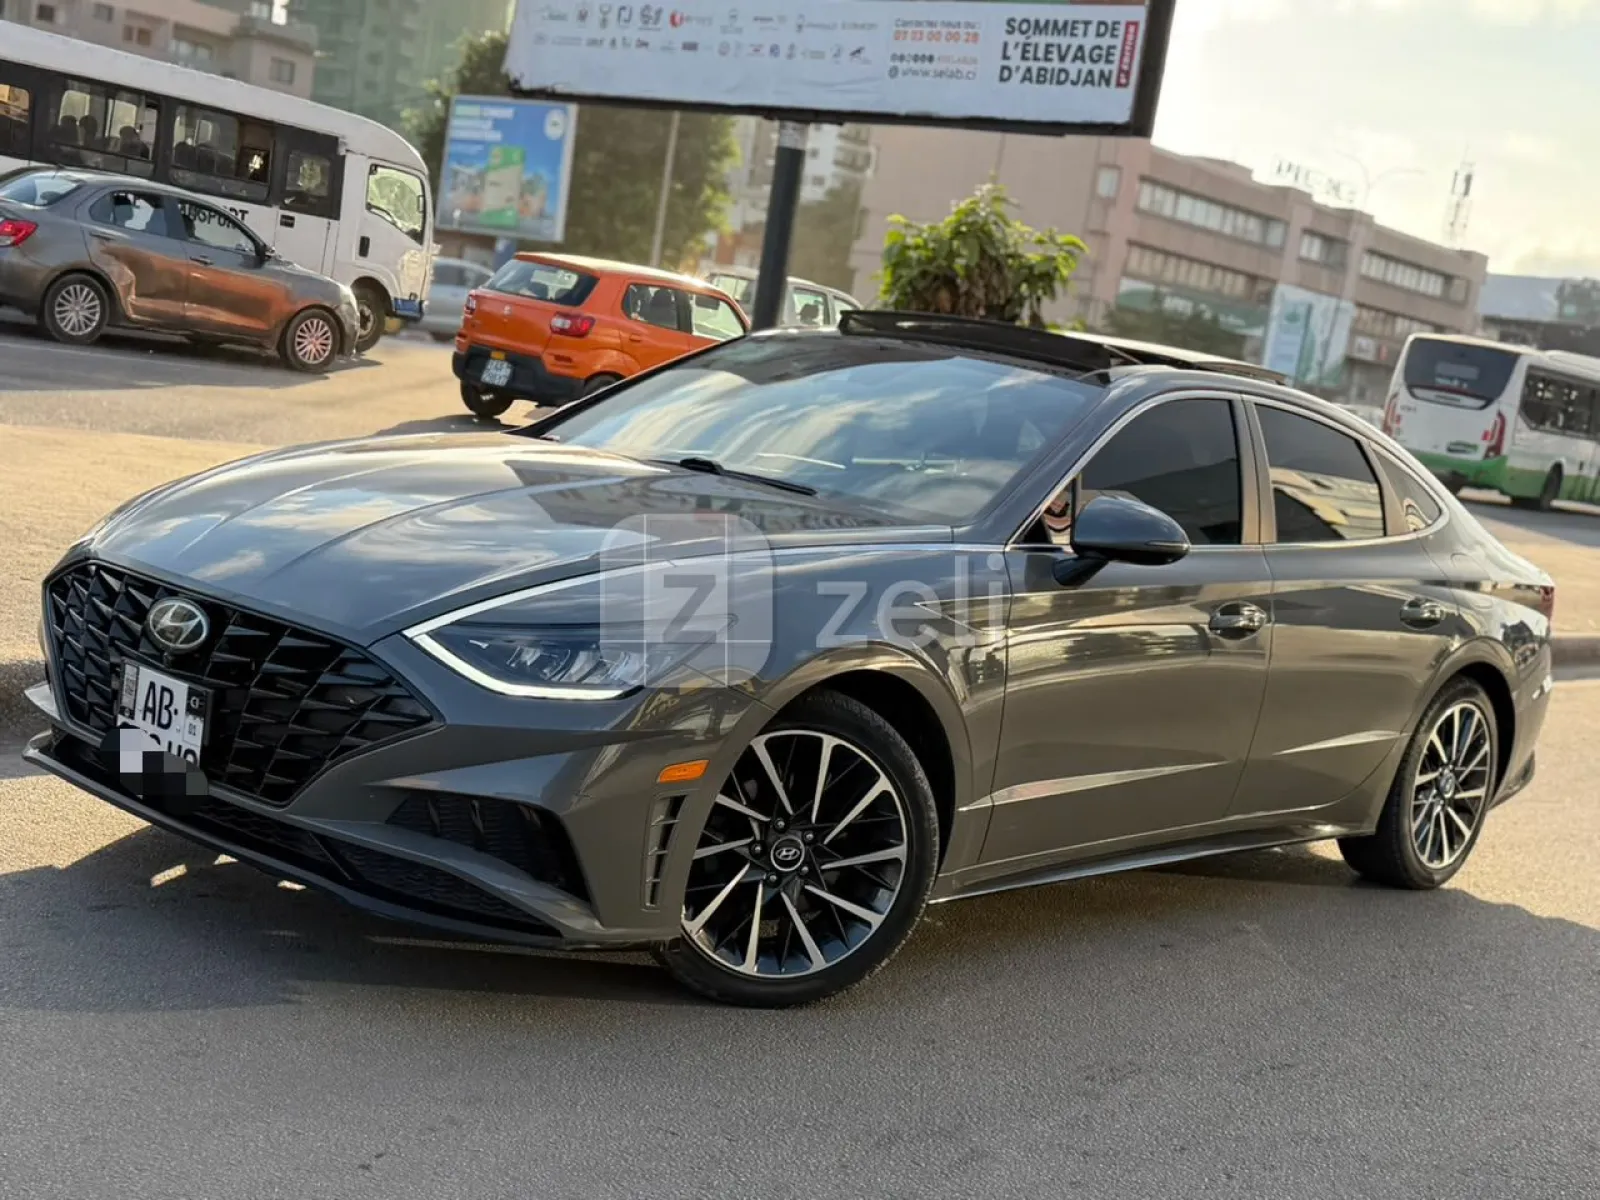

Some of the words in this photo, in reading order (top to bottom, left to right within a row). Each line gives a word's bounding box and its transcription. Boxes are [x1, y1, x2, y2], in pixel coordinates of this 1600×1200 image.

[1005, 17, 1093, 38] SOMMET
[1095, 20, 1121, 39] DE
[999, 65, 1113, 88] D'ABIDJAN
